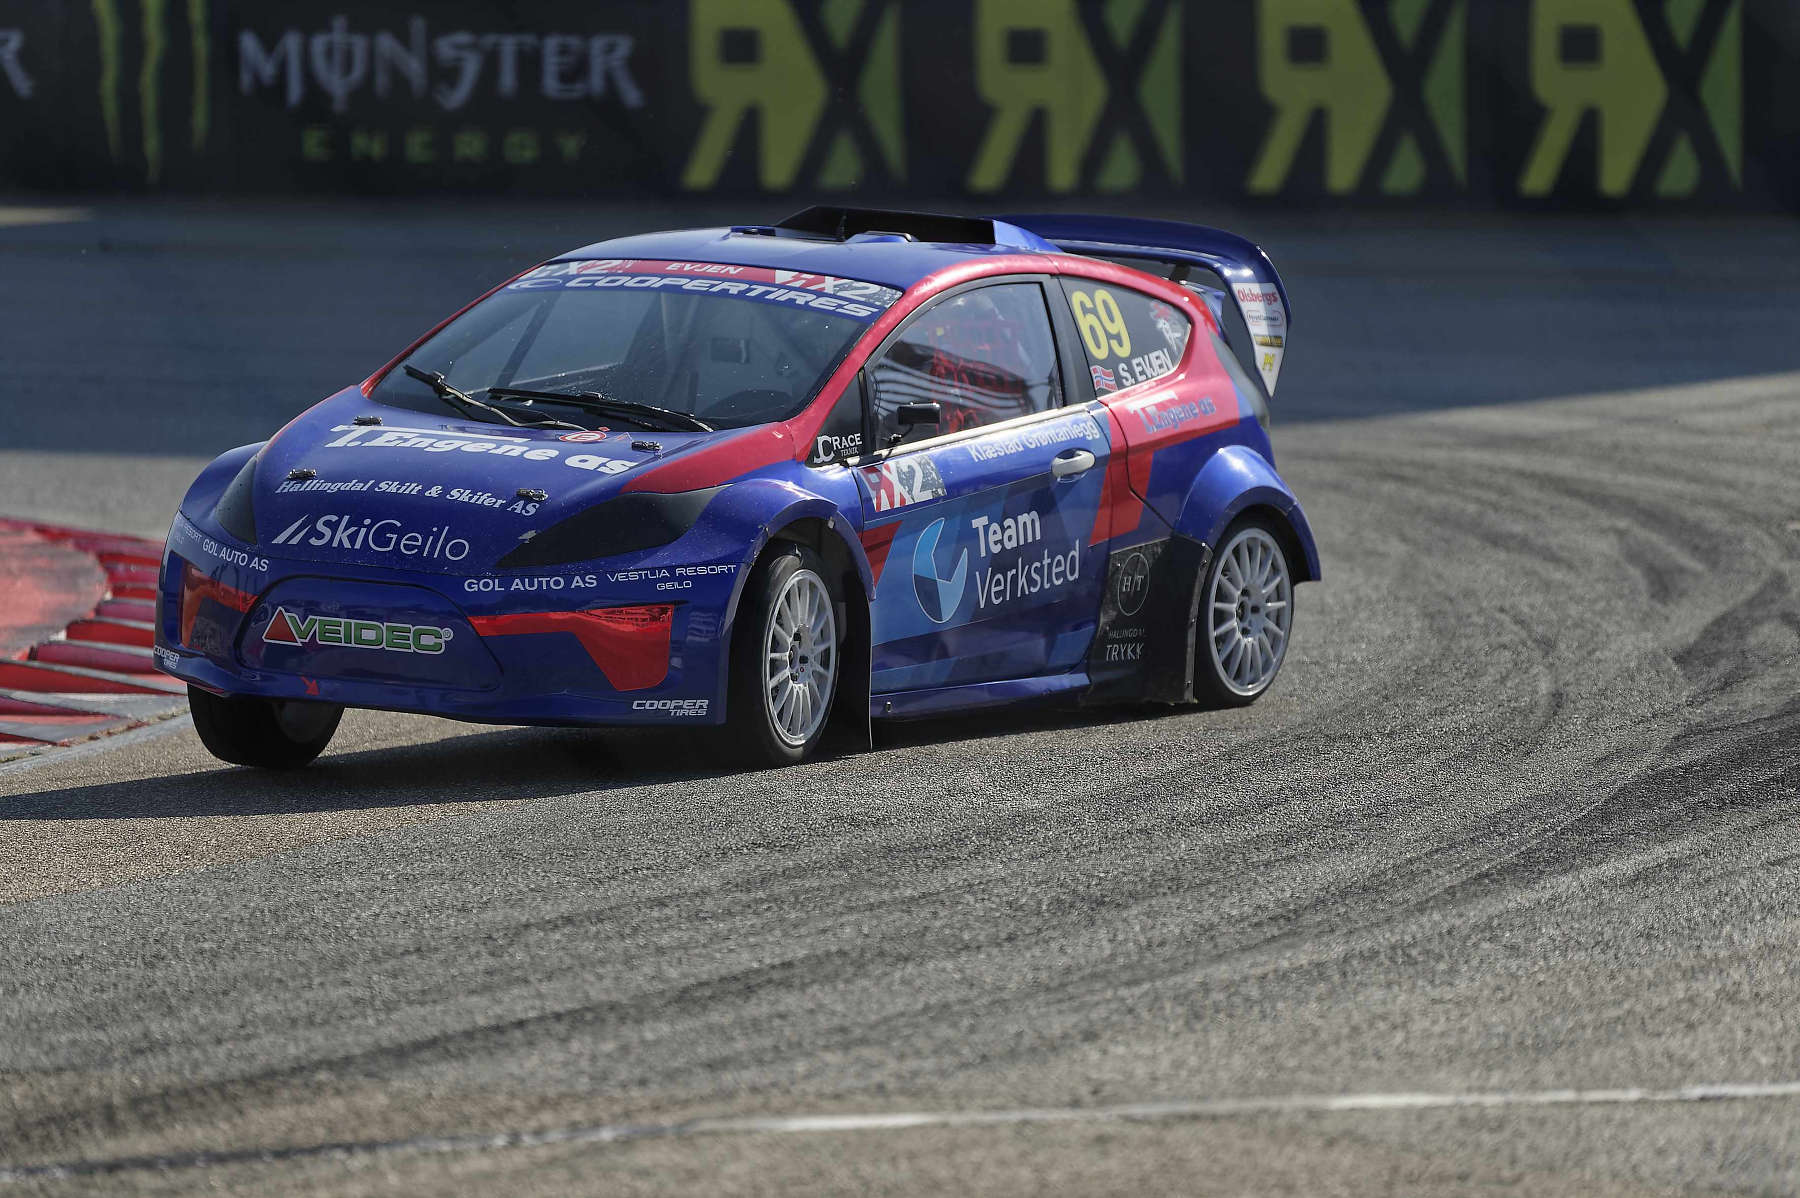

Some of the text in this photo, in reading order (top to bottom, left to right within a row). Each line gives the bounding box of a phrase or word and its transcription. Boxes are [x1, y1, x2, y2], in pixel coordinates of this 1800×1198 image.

[238, 15, 645, 111] MONSTER
[302, 127, 588, 163] ENERGY
[665, 263, 744, 275] EVJEN
[1071, 290, 1132, 360] 69
[1118, 349, 1172, 385] S. EVJEN
[324, 425, 640, 475] T.Engene as
[832, 433, 862, 450] RACE
[275, 480, 539, 516] Hallingdal Skilt & Skifer AS
[307, 514, 470, 561] SkiGeilo
[972, 510, 1042, 558] Team
[202, 538, 219, 556] GOL
[219, 546, 248, 566] AUTO
[249, 557, 269, 572] AS
[464, 574, 597, 592] GOL AUTO AS
[606, 564, 736, 582] VESTLIA RESORT
[656, 580, 692, 591] GEILO
[975, 539, 1081, 609] Verksted
[154, 645, 180, 663] COOPER
[632, 699, 709, 710] COOPER
[669, 709, 708, 717] TIRES
